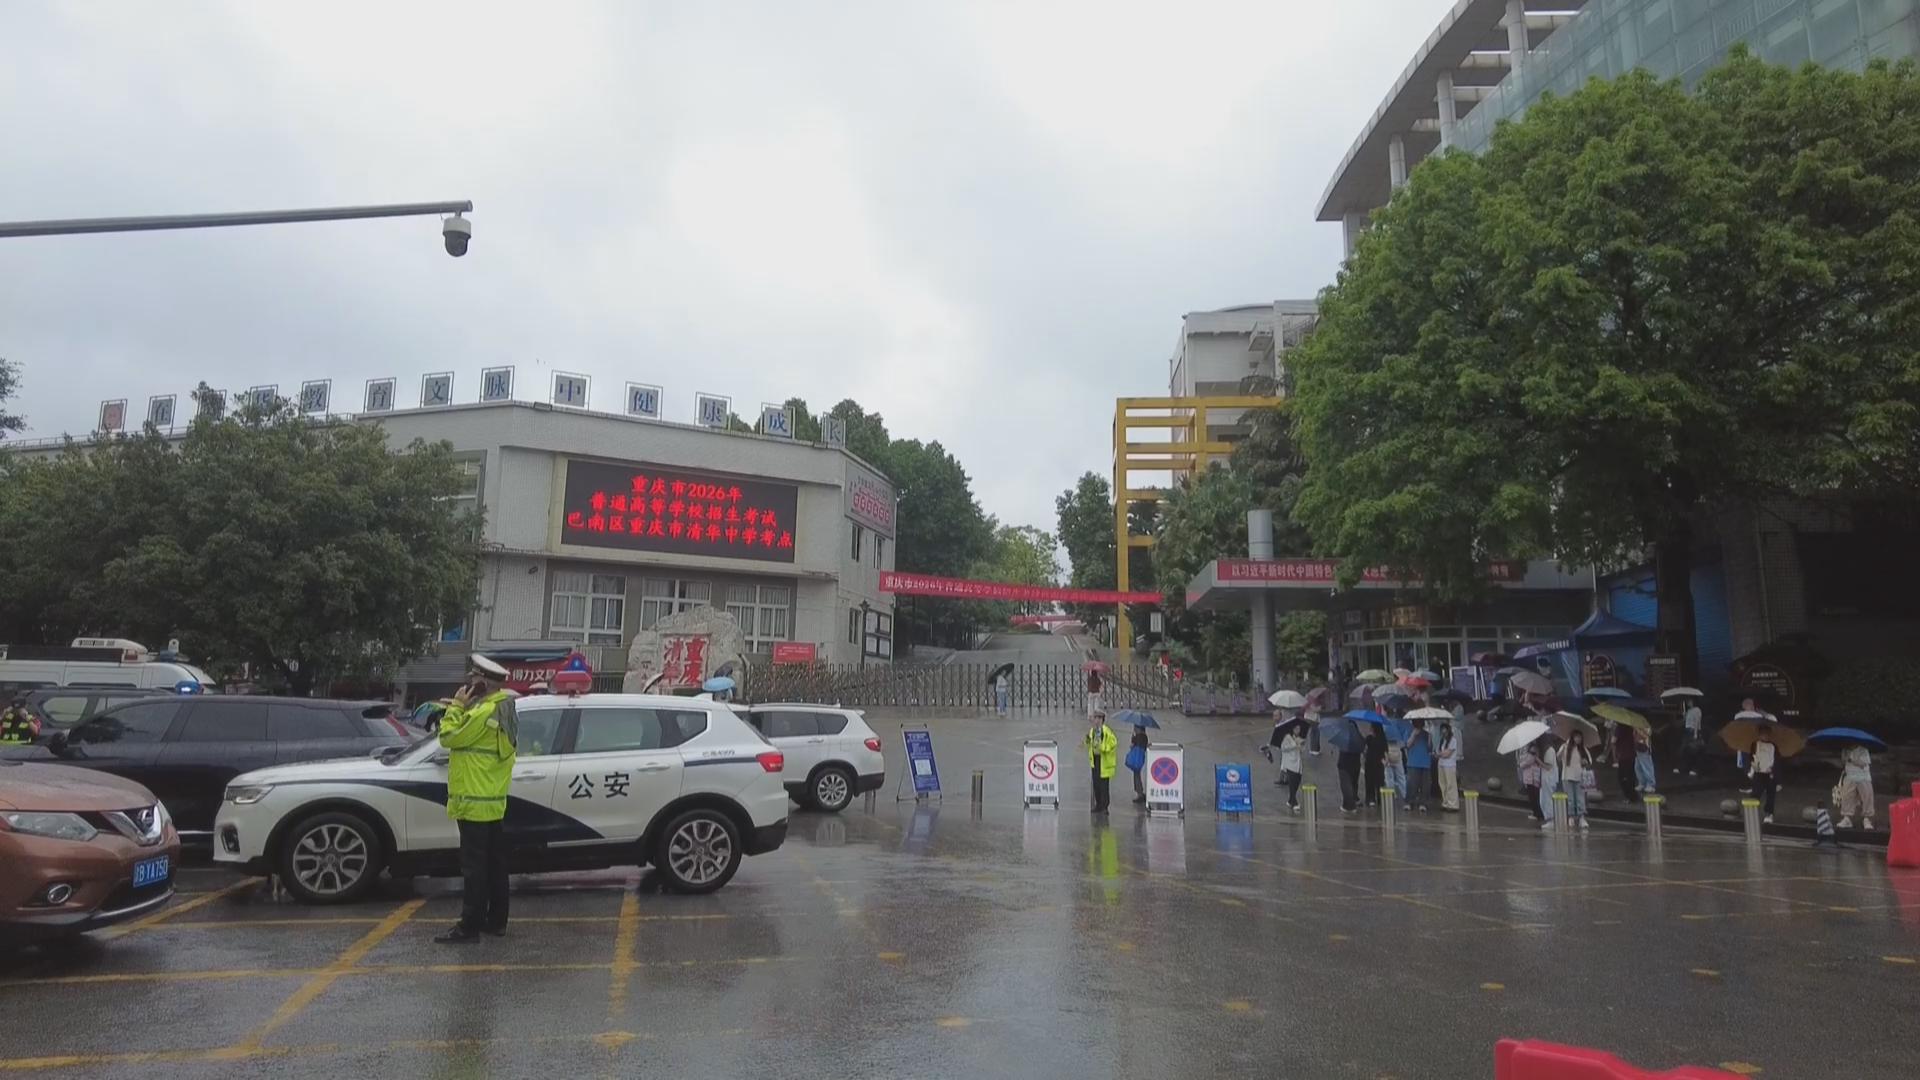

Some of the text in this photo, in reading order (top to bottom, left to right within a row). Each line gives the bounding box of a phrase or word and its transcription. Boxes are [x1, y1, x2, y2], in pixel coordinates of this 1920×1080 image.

[630, 475, 742, 503] 重庆市2026年
[589, 491, 777, 528] 普通高等学校招生考试
[567, 511, 792, 548] 巴南区重庆市清华中学考点
[568, 772, 630, 800] 公安
